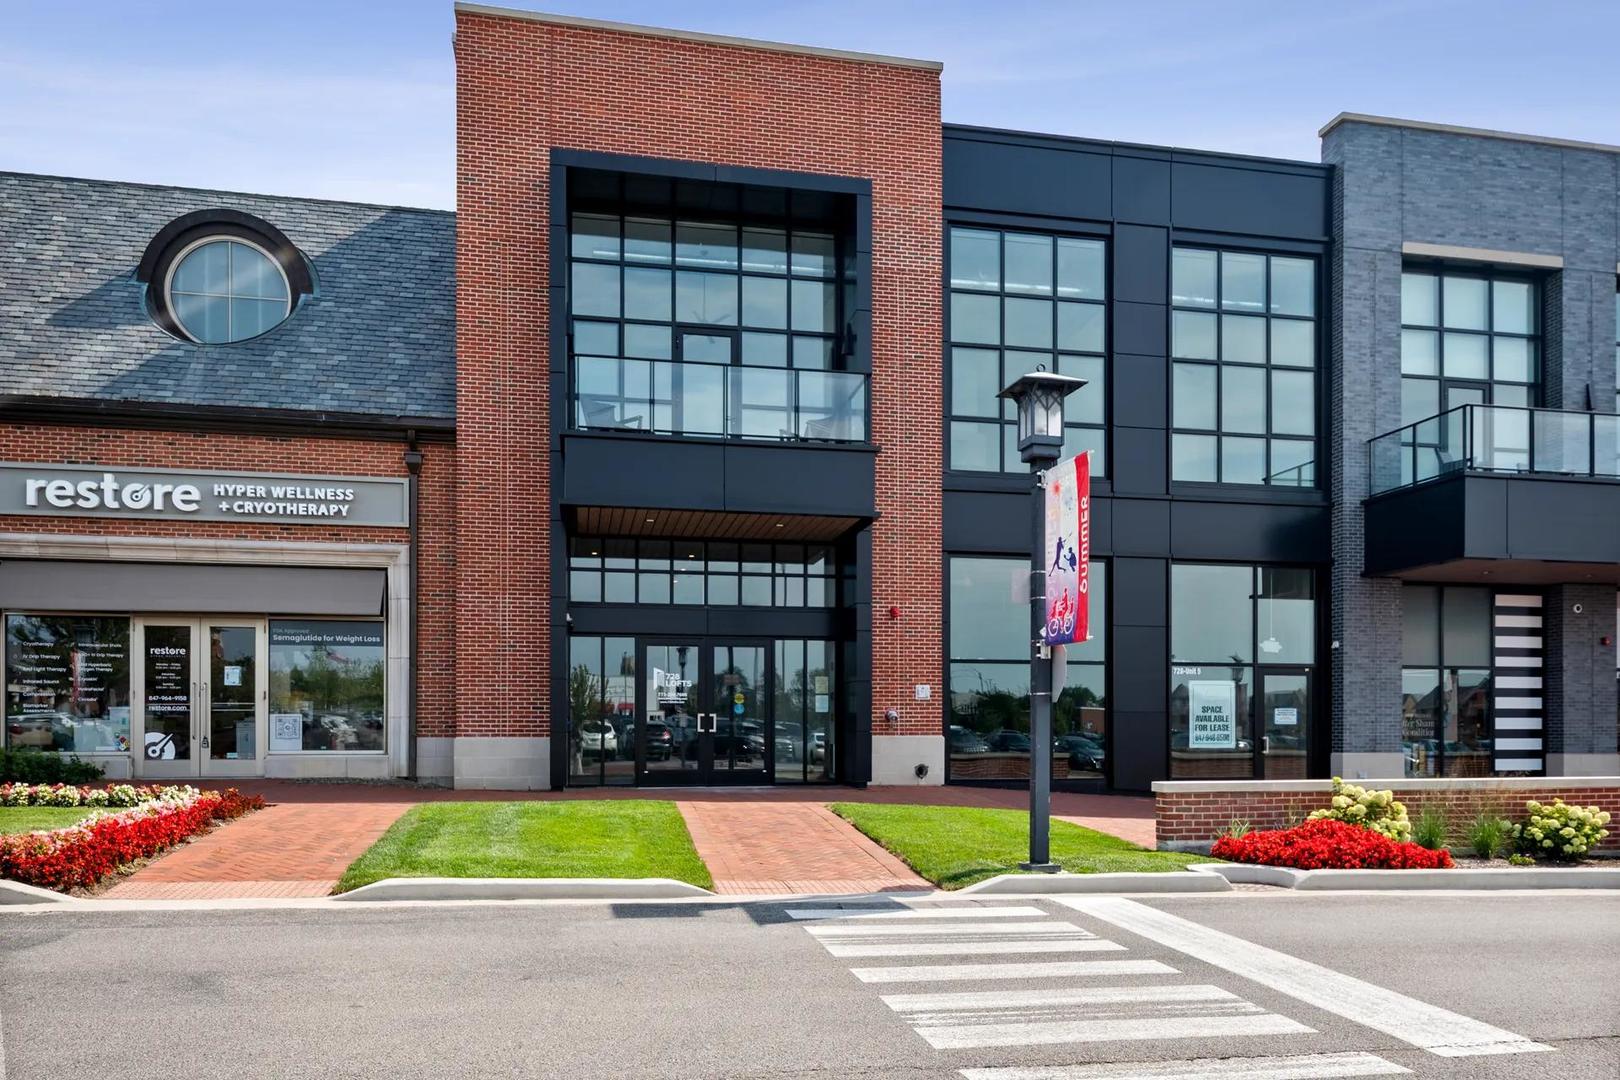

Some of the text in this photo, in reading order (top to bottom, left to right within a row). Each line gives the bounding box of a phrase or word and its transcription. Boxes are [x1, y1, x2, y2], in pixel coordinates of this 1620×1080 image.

[26, 474, 201, 512] restore
[213, 484, 354, 500] HYPER WELLNESS
[272, 634, 322, 642] Semaglutide
[335, 635, 362, 644] Weight
[150, 646, 186, 655] restore
[1202, 706, 1223, 714] SPACE
